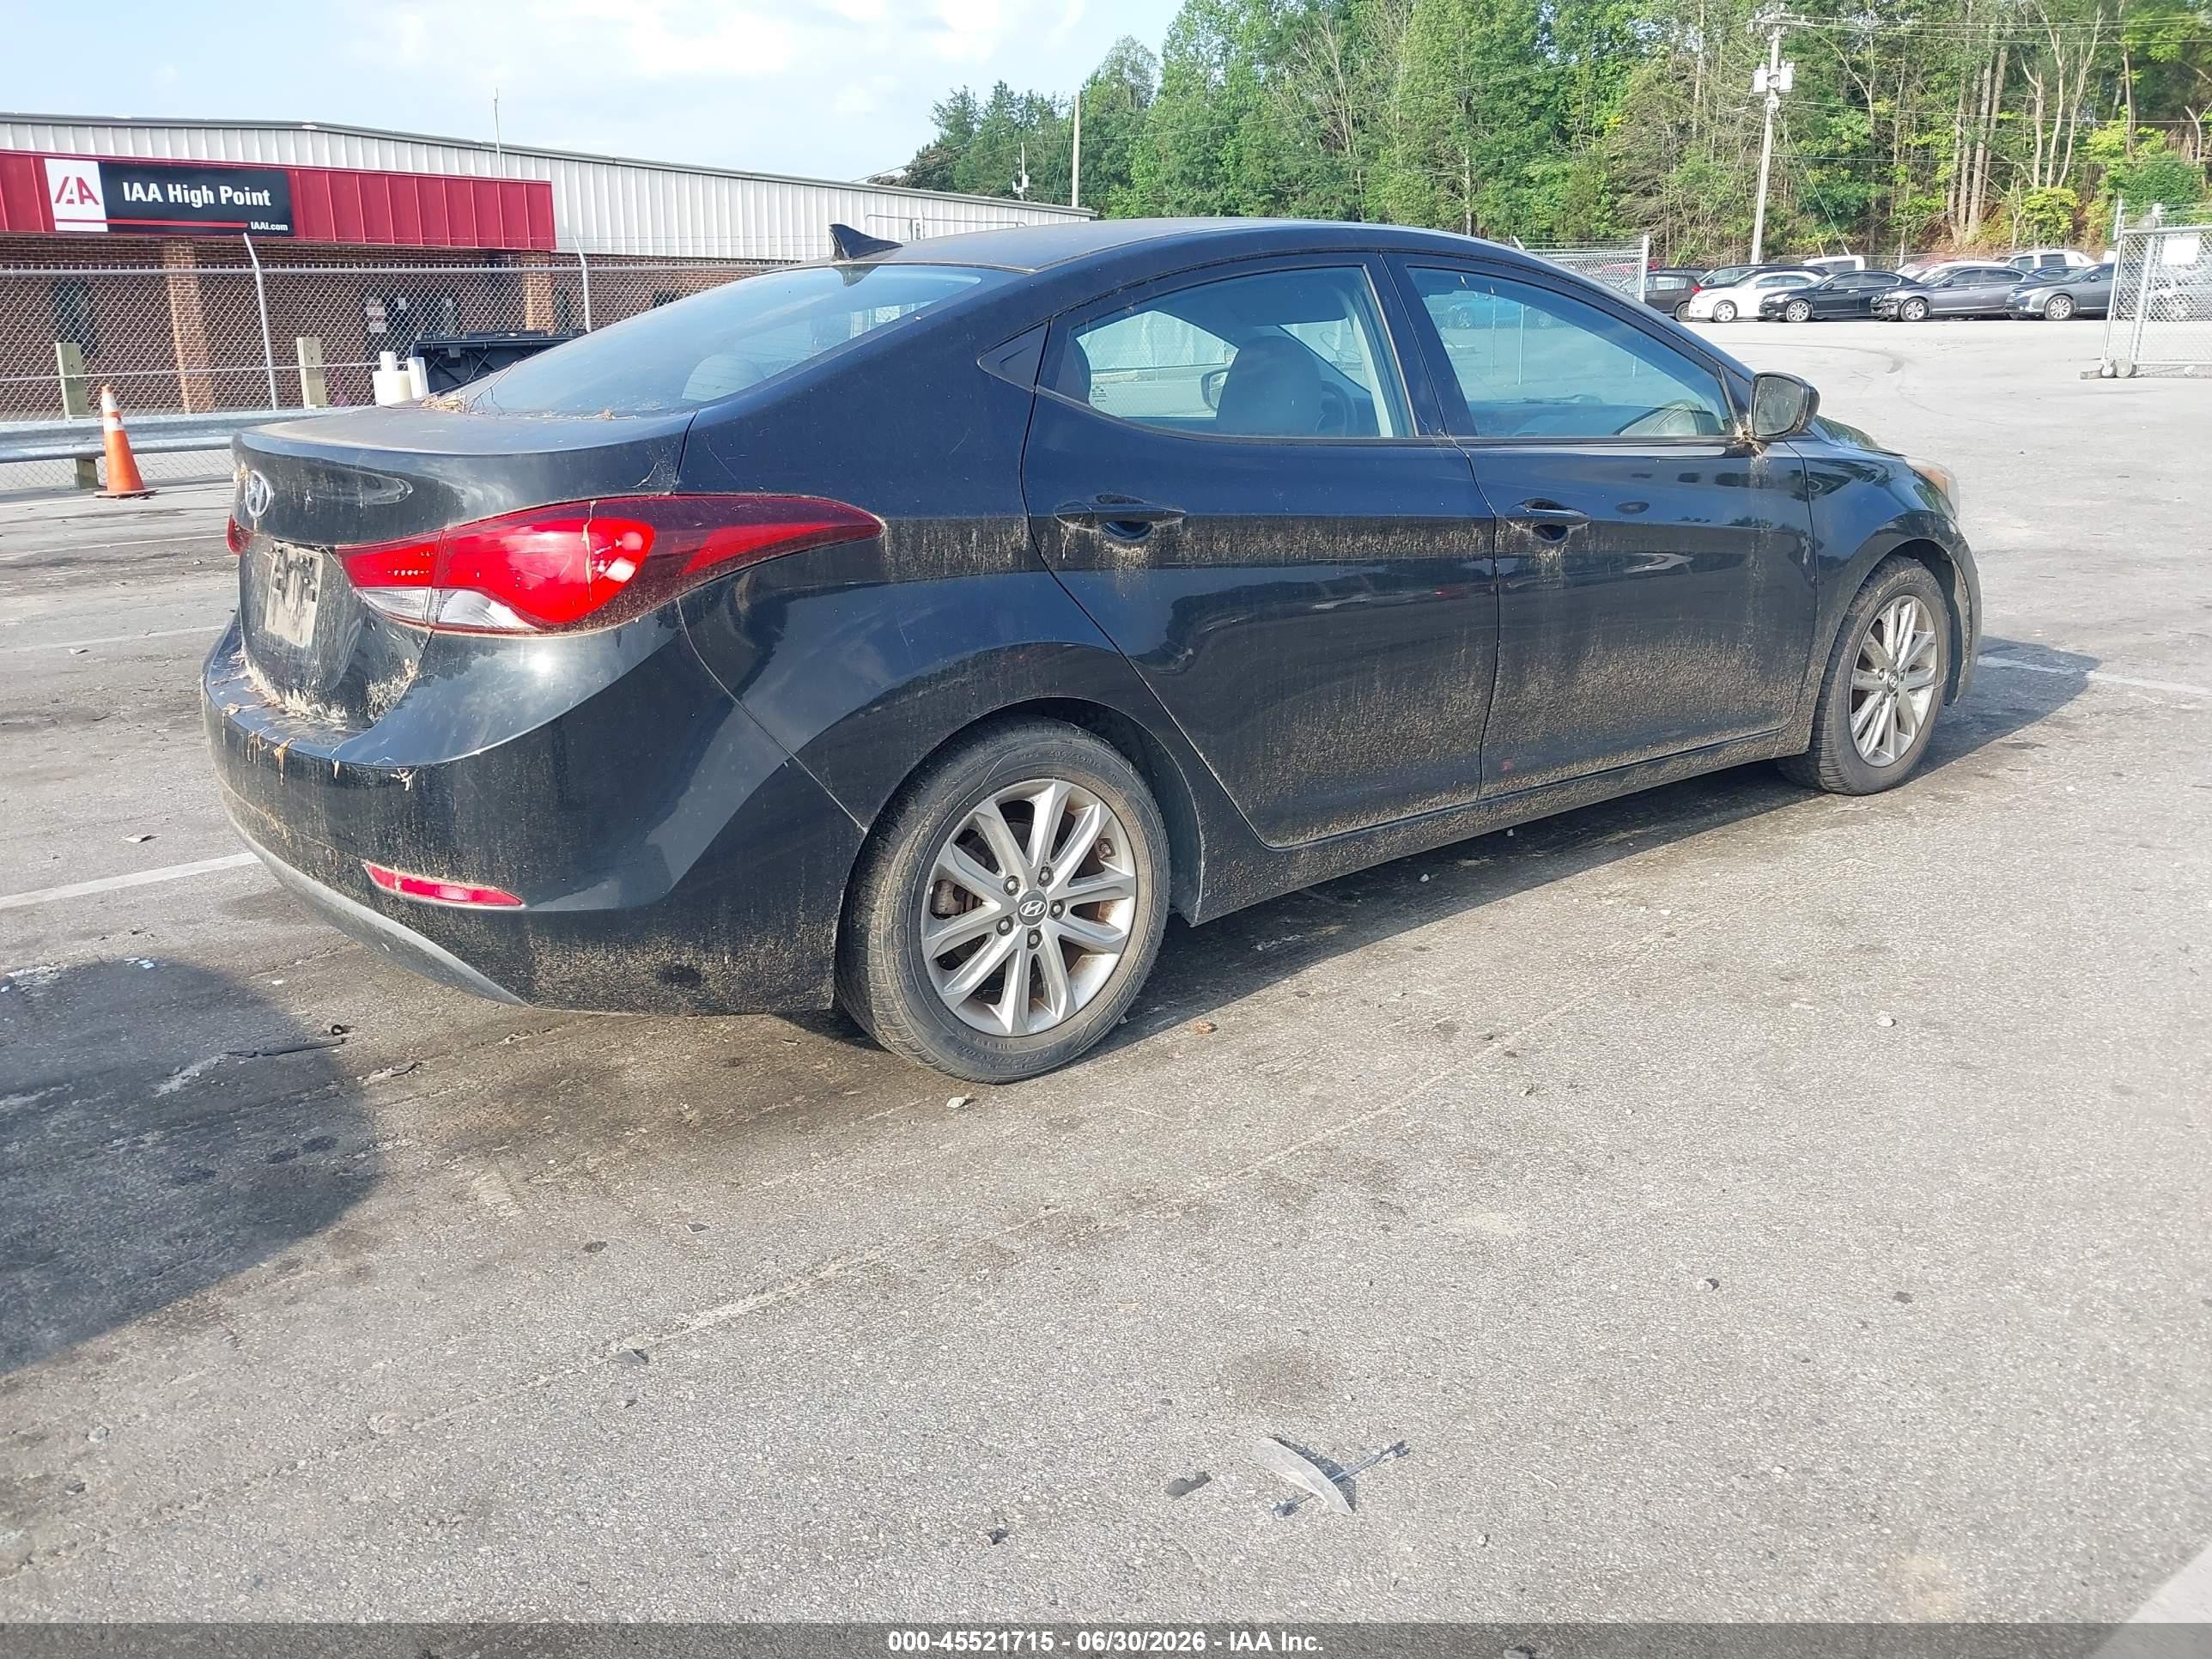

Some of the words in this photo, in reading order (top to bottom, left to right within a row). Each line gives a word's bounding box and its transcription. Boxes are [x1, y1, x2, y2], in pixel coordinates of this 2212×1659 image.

[122, 181, 164, 203] IAA
[167, 183, 215, 208] High
[219, 185, 271, 207] Point
